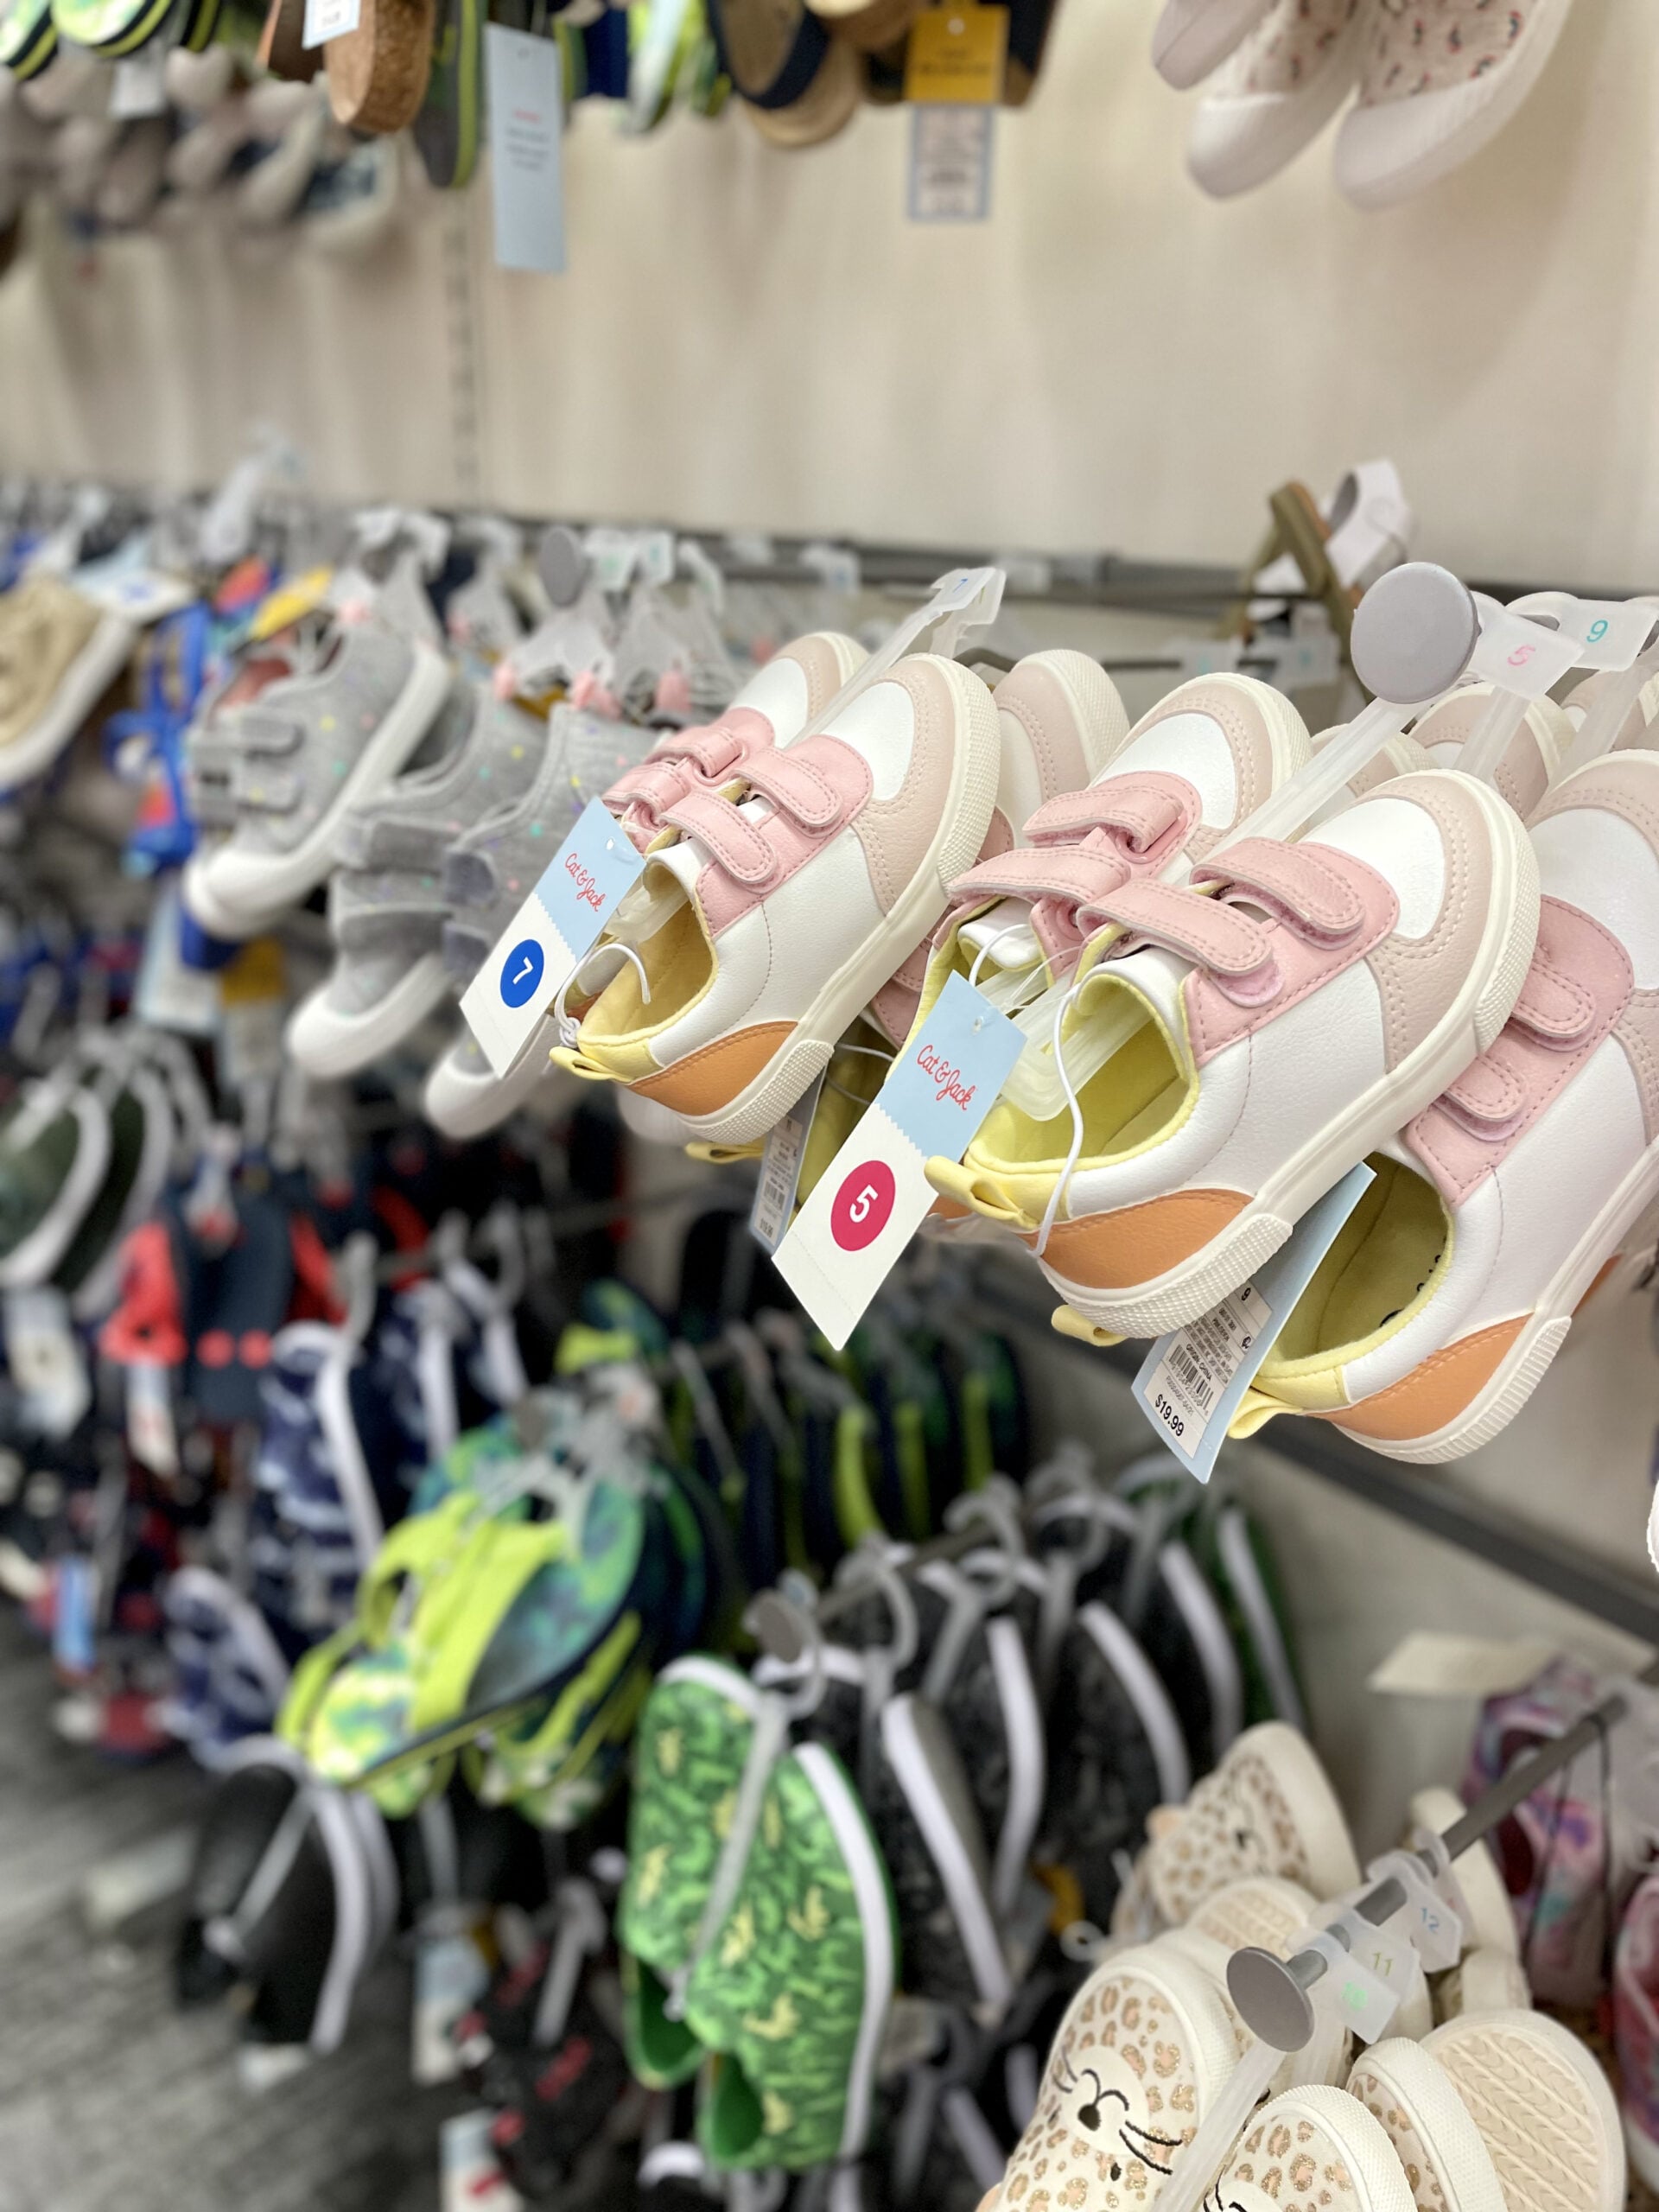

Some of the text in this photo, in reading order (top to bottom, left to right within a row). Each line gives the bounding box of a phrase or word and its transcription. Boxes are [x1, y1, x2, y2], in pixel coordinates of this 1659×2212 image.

[1586, 620, 1608, 643] 9
[1507, 645, 1535, 666] 5
[565, 853, 606, 912] Cat & Jack
[512, 956, 534, 985] 7
[917, 1044, 976, 1111] Cat & Jack
[849, 1184, 879, 1224] 5
[1241, 1287, 1251, 1301] 9
[1154, 1394, 1185, 1437] $19.99
[1421, 1907, 1440, 1935] 12
[1372, 1952, 1395, 1977] 11
